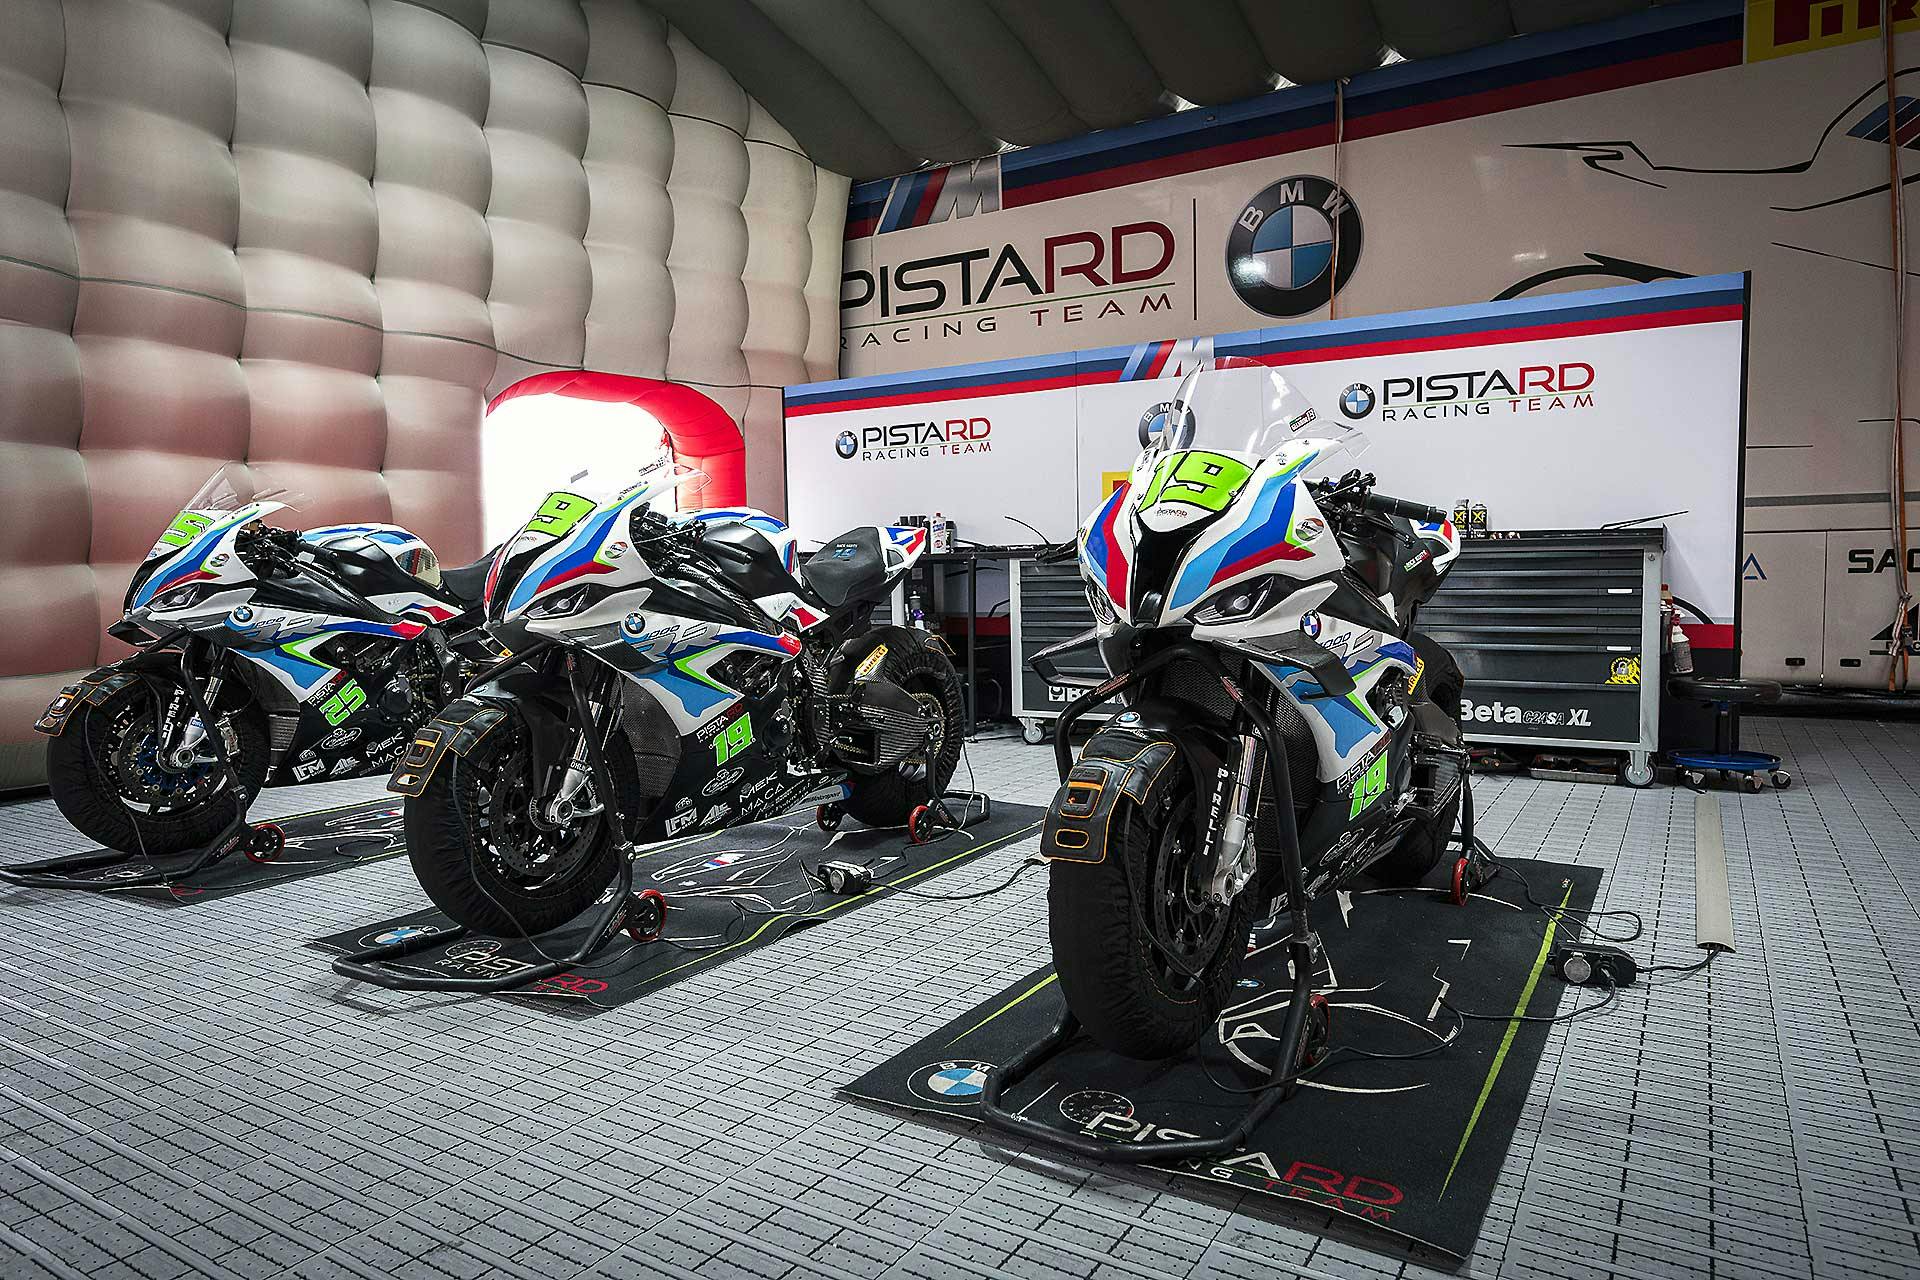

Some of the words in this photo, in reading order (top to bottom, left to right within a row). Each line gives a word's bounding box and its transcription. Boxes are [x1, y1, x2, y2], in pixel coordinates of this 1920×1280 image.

[1238, 180, 1350, 232] BMW
[1030, 292, 1172, 327] TEAM
[1342, 382, 1372, 397] BMW
[1383, 362, 1595, 405] PISTARD
[1382, 402, 1490, 422] RACING
[1508, 393, 1594, 412] TEAM
[862, 417, 992, 449] PISTARD
[862, 447, 930, 461] RACING
[940, 441, 992, 455] TEAM
[1137, 450, 1256, 512] 19
[160, 511, 216, 547] 5
[319, 678, 367, 726] 25
[1460, 698, 1522, 724] Beta
[1566, 708, 1592, 727] XL
[365, 731, 405, 758] MEK
[713, 711, 754, 767] 19
[739, 770, 778, 803] MEK
[740, 783, 785, 816] MACA
[1349, 749, 1389, 821] 19
[1203, 767, 1229, 855] PIRELLI
[435, 957, 502, 978] RACIN
[452, 950, 609, 994] PISTRD
[940, 1062, 991, 1073] BM
[1086, 1111, 1404, 1206] PIARD
